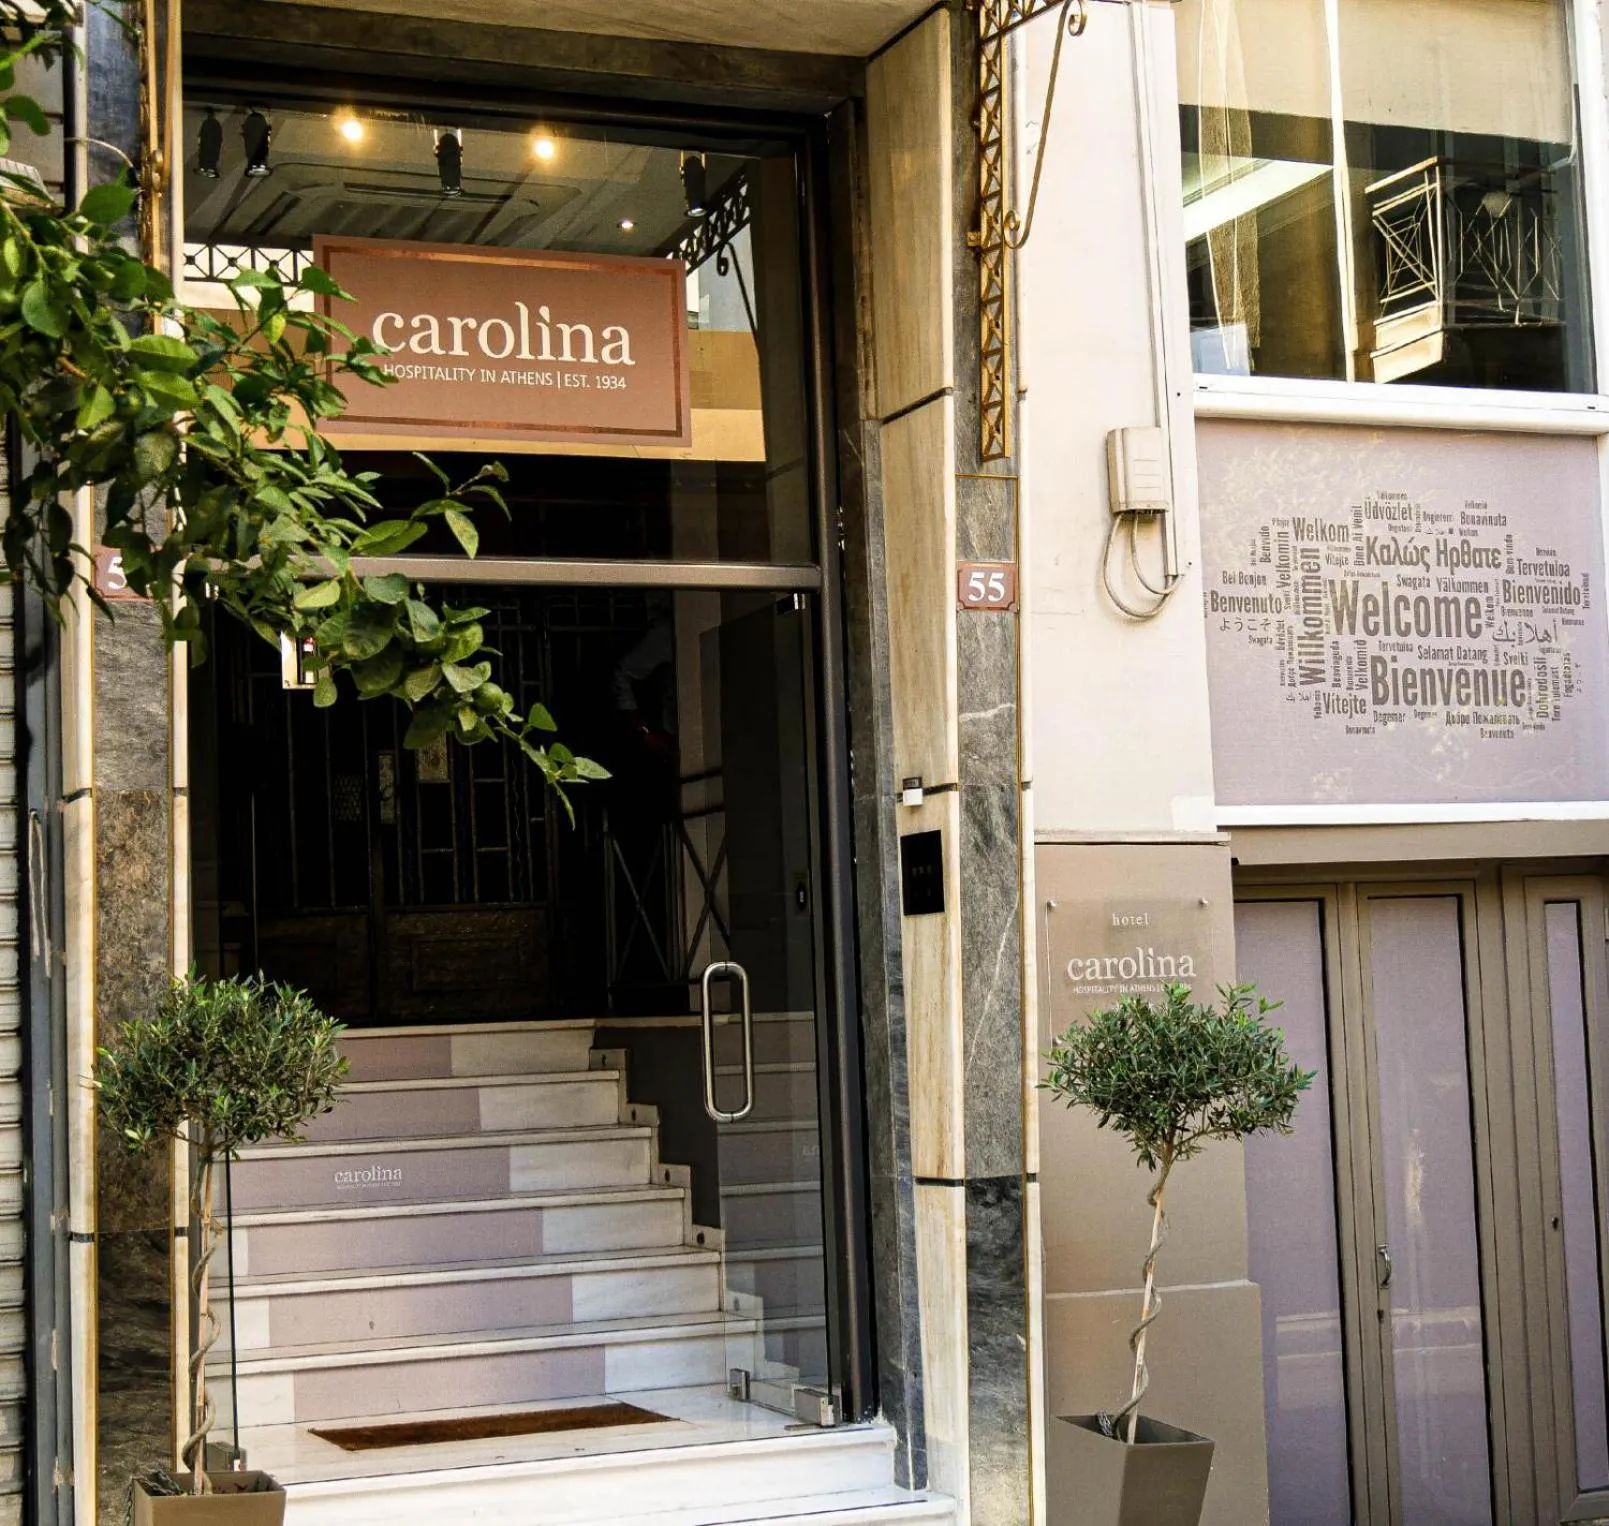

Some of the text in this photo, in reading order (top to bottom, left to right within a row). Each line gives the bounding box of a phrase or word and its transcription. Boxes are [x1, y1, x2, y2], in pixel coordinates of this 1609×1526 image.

[372, 301, 635, 366] carolina
[384, 363, 627, 390] HOSPITALITY IN ATHENS EST. 1934
[1292, 517, 1350, 543] Welkom
[1275, 530, 1291, 589] Velkomin
[1366, 536, 1431, 573] Καλώς
[1516, 558, 1571, 577] Tervetuloa
[107, 556, 128, 590] 5
[968, 571, 1006, 602] 55
[1210, 589, 1282, 614] Benvenuto
[1502, 579, 1581, 606] Bienvenido
[1220, 617, 1272, 632] ようこそ
[1297, 546, 1326, 687] Willkommen
[1327, 579, 1483, 639] Welcome
[1370, 655, 1526, 708] Bienvenue
[1112, 912, 1149, 927] hotel
[1066, 946, 1197, 981] carolina
[334, 1165, 402, 1183] carolina
